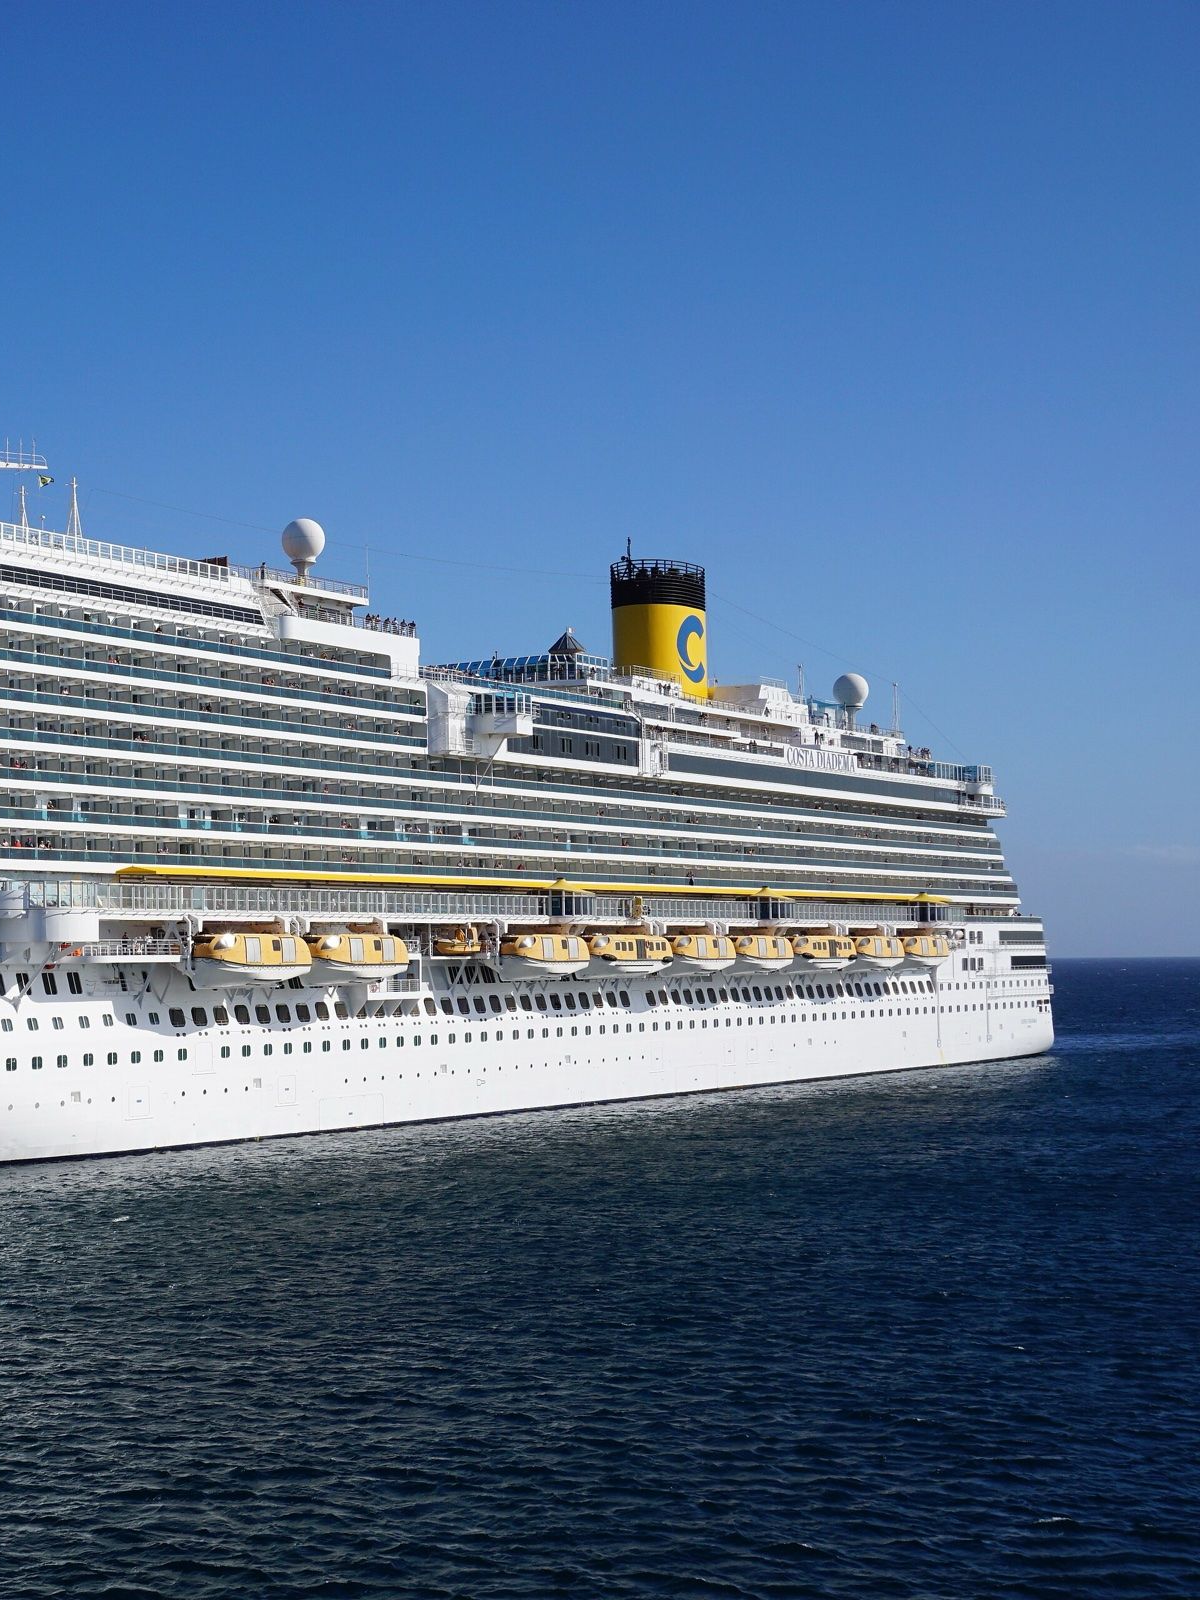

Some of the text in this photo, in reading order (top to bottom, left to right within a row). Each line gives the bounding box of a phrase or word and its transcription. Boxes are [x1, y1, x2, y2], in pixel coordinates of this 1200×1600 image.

[677, 615, 705, 683] C
[787, 747, 856, 772] COSTA DIADEMA
